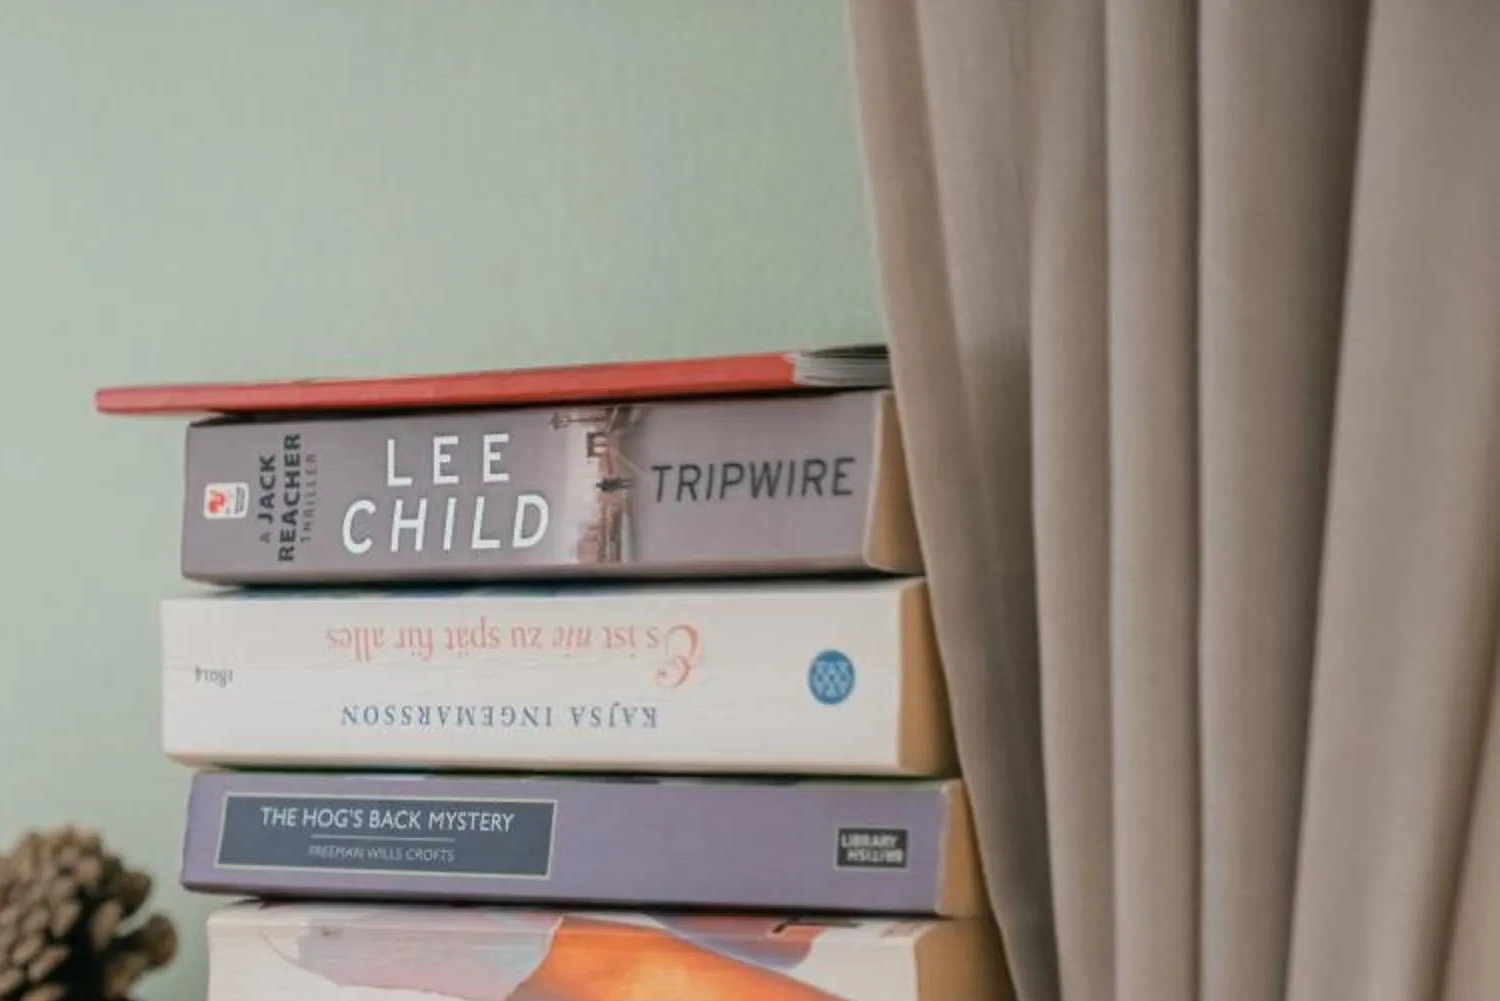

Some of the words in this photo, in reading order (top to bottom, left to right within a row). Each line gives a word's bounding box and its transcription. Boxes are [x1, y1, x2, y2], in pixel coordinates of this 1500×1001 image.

[387, 433, 510, 487] LEE
[257, 454, 276, 525] JACK
[277, 433, 301, 562] REACHER
[651, 457, 856, 503] TRIPWIRE
[300, 453, 317, 544] THRILLER
[258, 531, 272, 545] A
[342, 495, 550, 554] CHILD
[326, 626, 386, 662] alles
[395, 624, 434, 661] für
[445, 616, 500, 658] spät
[510, 624, 543, 648] zu
[552, 625, 591, 659] nie
[604, 625, 636, 659] ist
[341, 704, 552, 729] INGEMARSSON
[571, 702, 658, 728] KAJSA
[261, 806, 299, 828] THE
[302, 808, 364, 830] HOG'S
[369, 809, 422, 831] BACK
[428, 811, 515, 833] MYSTERY
